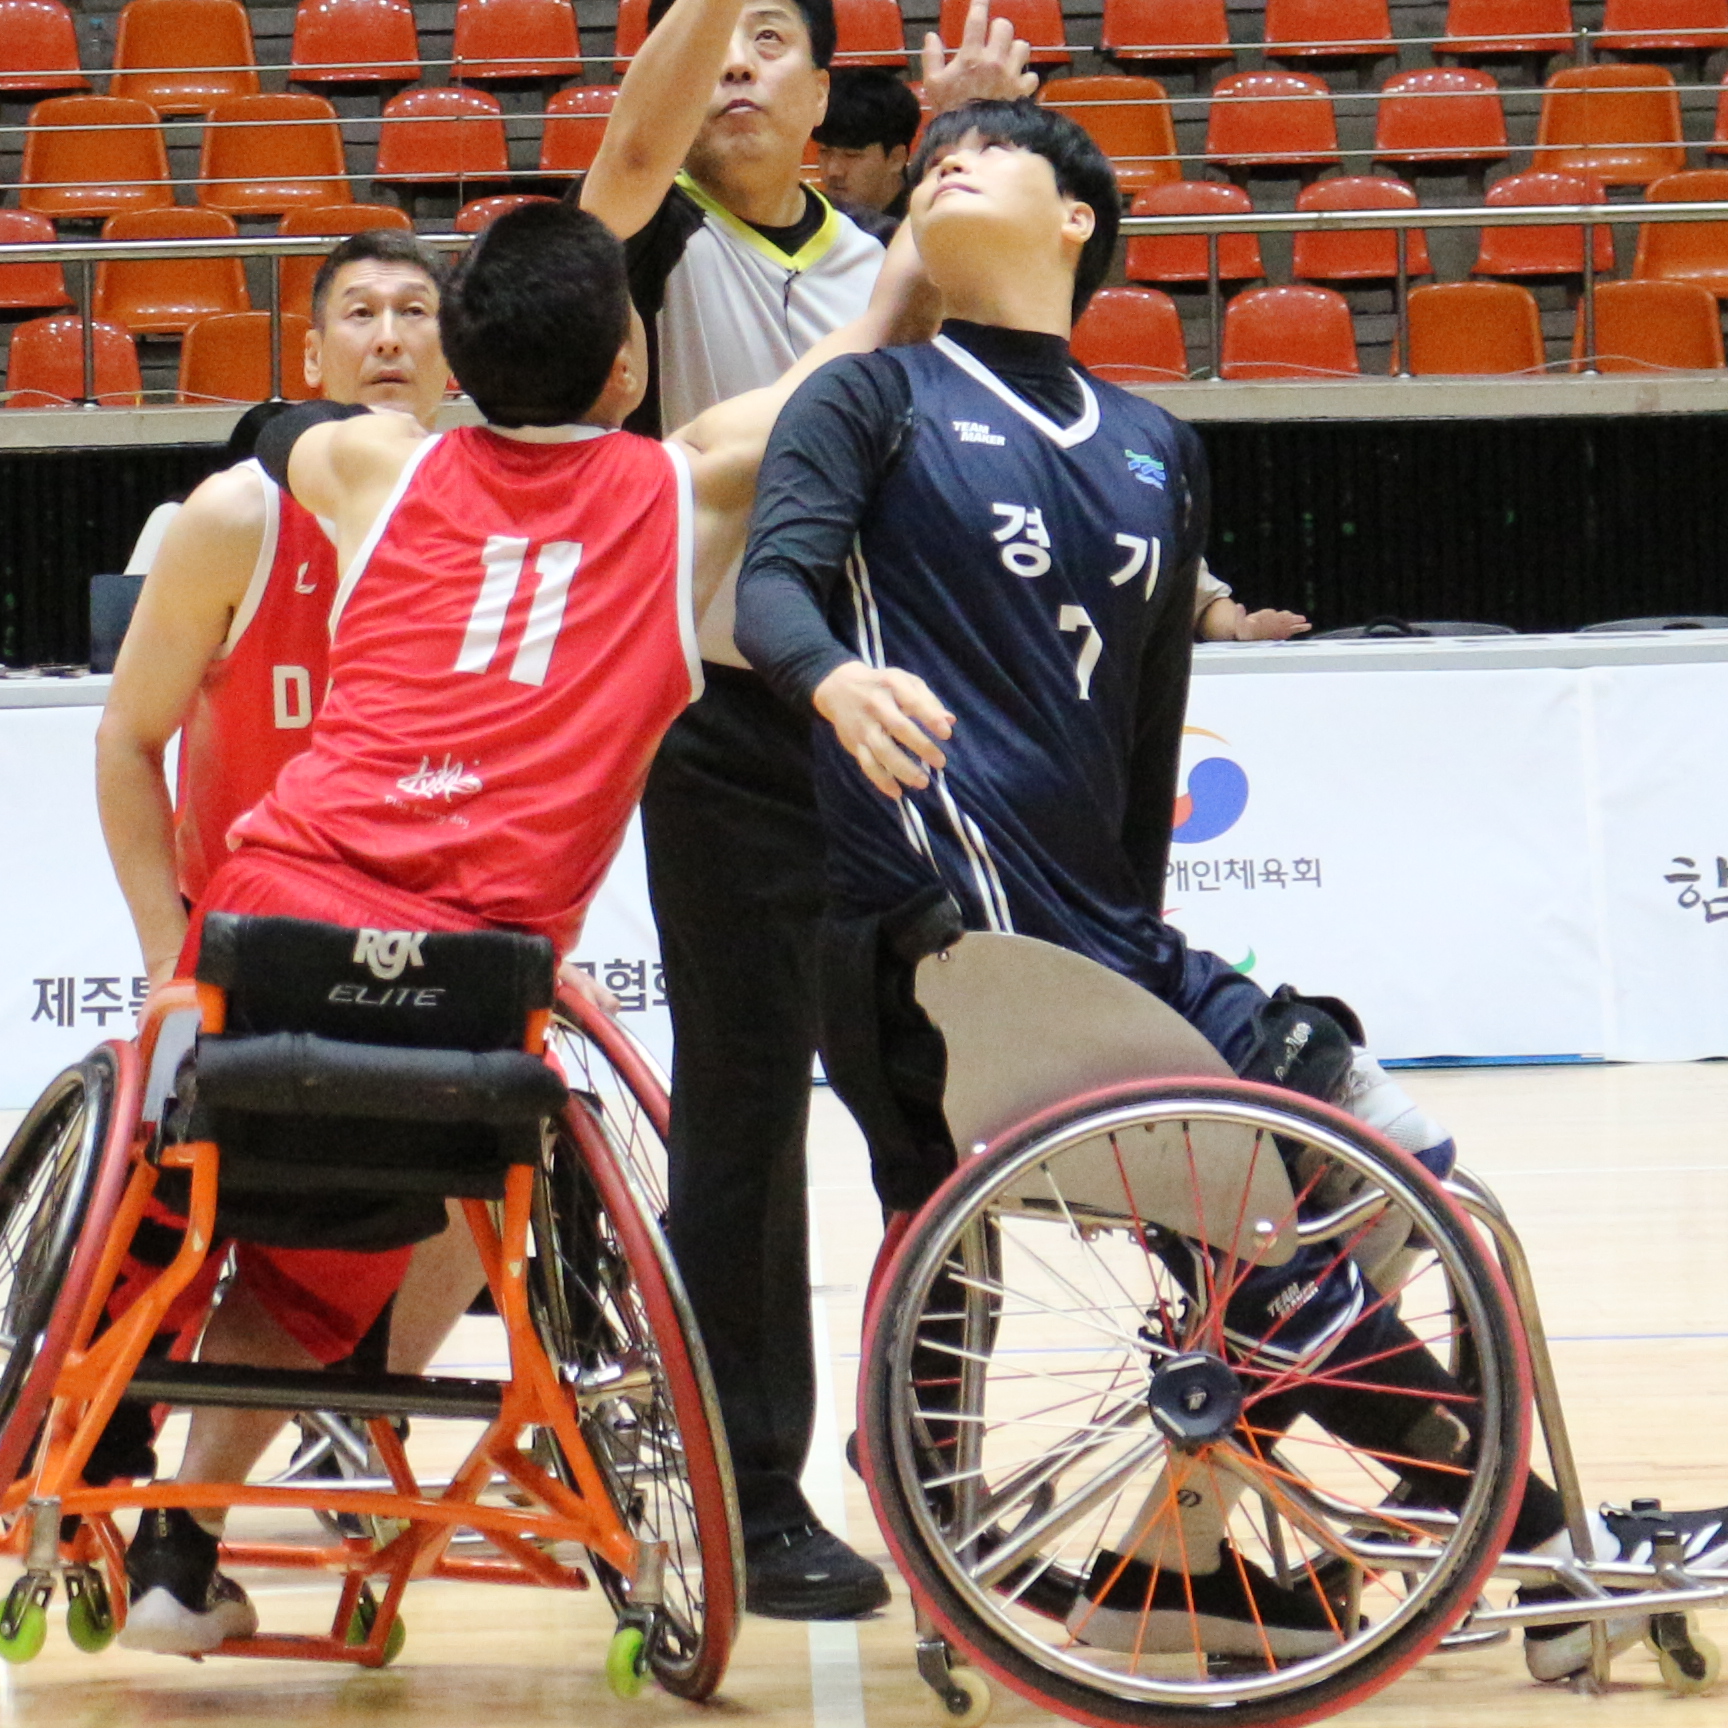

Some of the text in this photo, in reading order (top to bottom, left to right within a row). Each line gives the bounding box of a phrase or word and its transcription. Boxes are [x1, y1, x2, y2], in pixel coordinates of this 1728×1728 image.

[953, 421, 990, 434] TEAM
[960, 431, 1006, 447] MAKER
[454, 535, 583, 687] 11
[1059, 604, 1104, 701] 7
[328, 984, 447, 1007] ELITE
